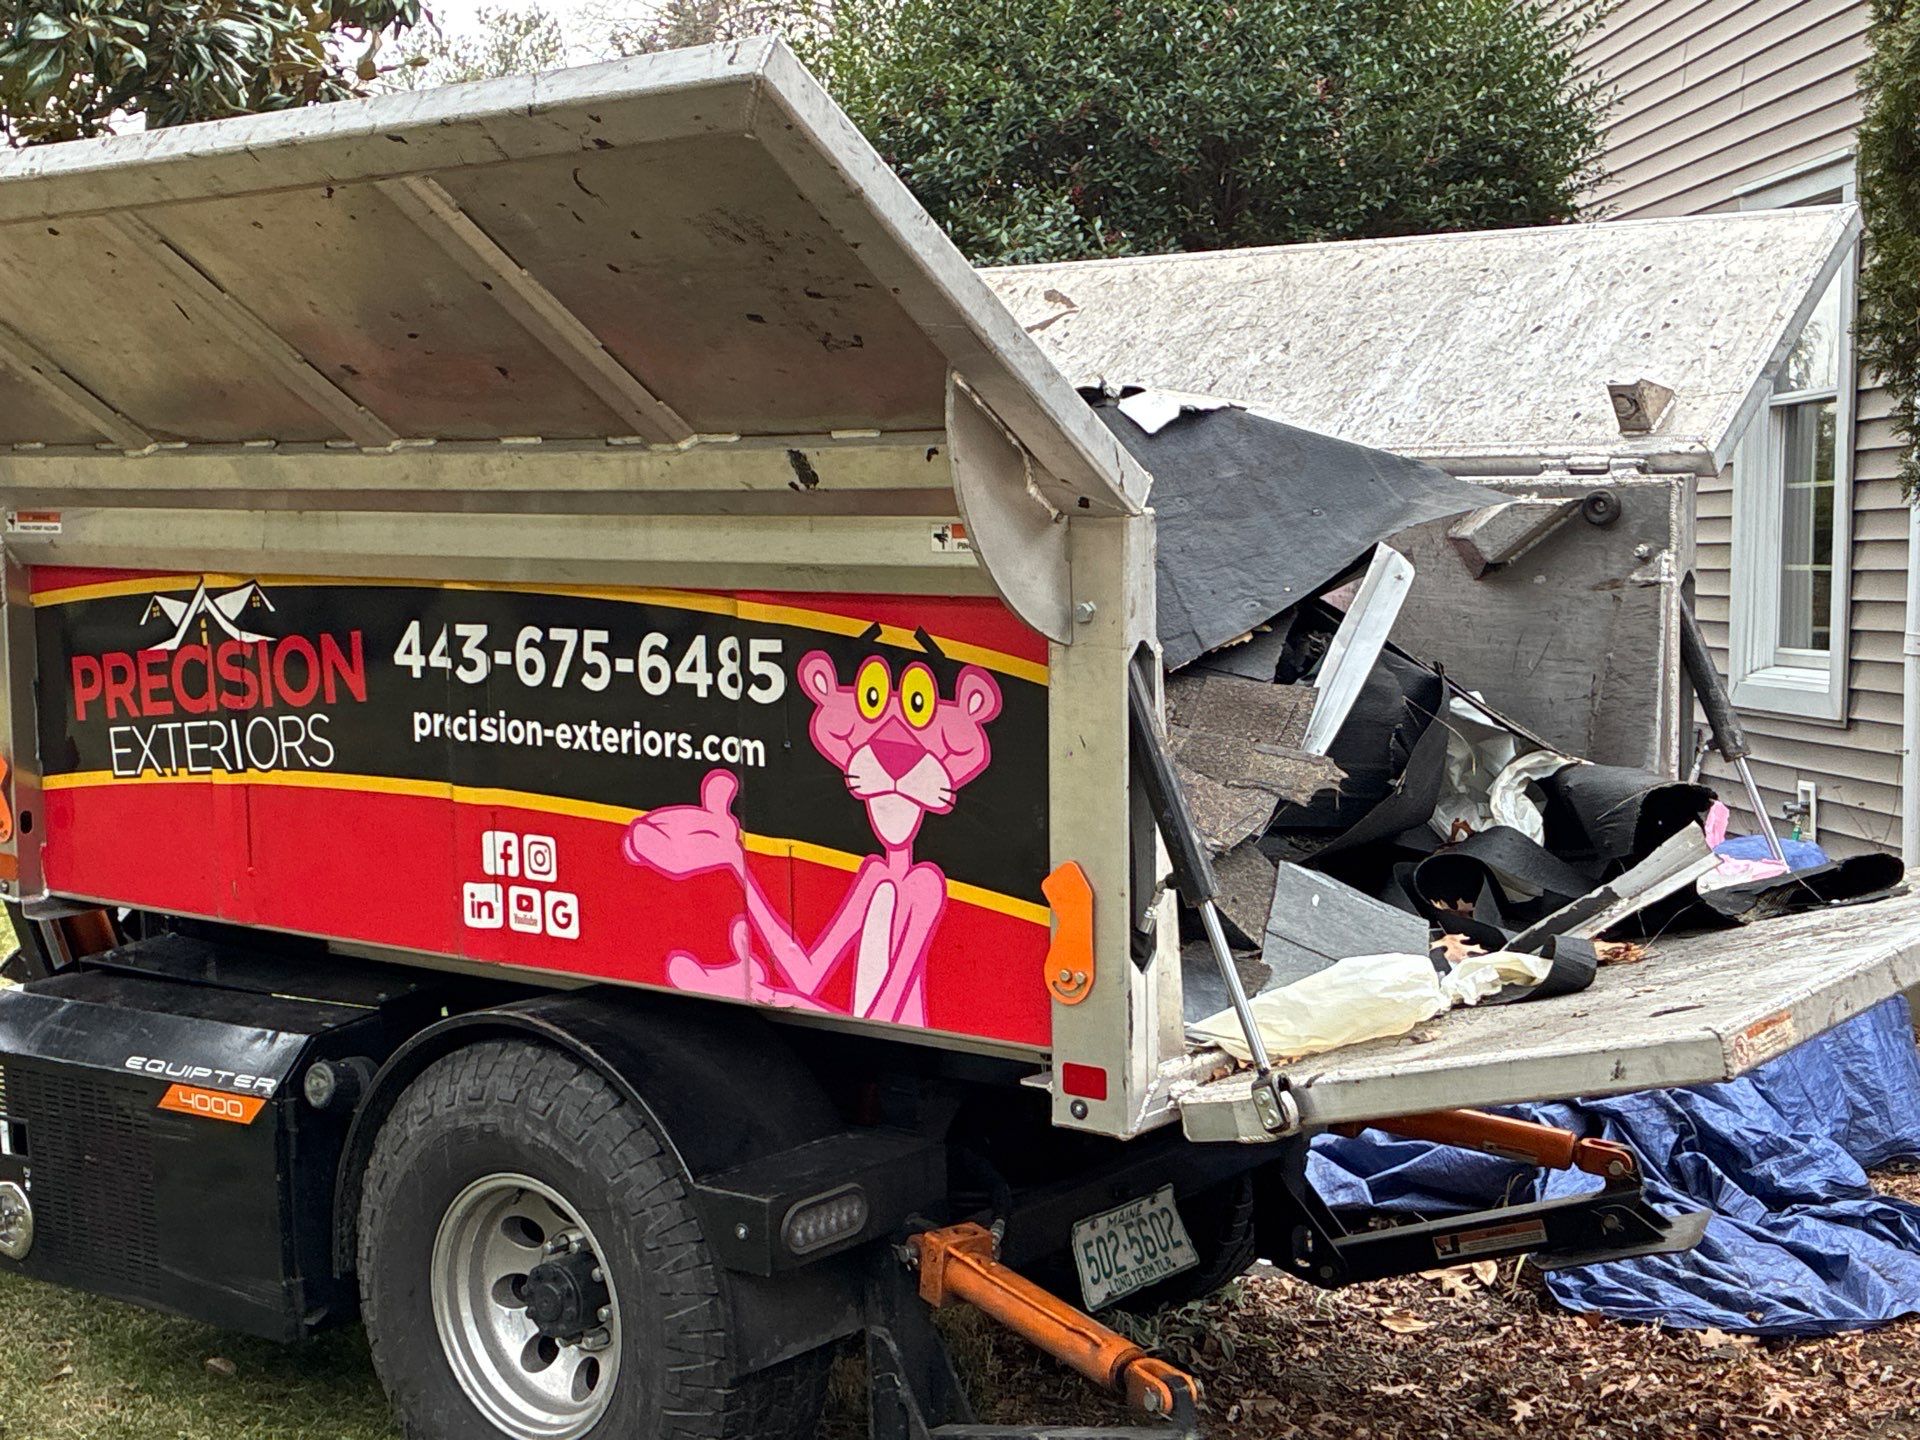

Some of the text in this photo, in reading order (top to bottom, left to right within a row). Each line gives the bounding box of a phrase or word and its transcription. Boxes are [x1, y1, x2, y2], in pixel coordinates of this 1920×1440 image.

[71, 629, 367, 722] PRECISION
[393, 619, 788, 705] 443-675-6485
[108, 713, 335, 777] EXTERIORS
[413, 708, 766, 768] precision-exteriors.com
[125, 1055, 277, 1093] EQUIPTER
[178, 1090, 243, 1118] 4000
[1107, 1203, 1144, 1228] MAINE
[1131, 1262, 1157, 1283] TERM
